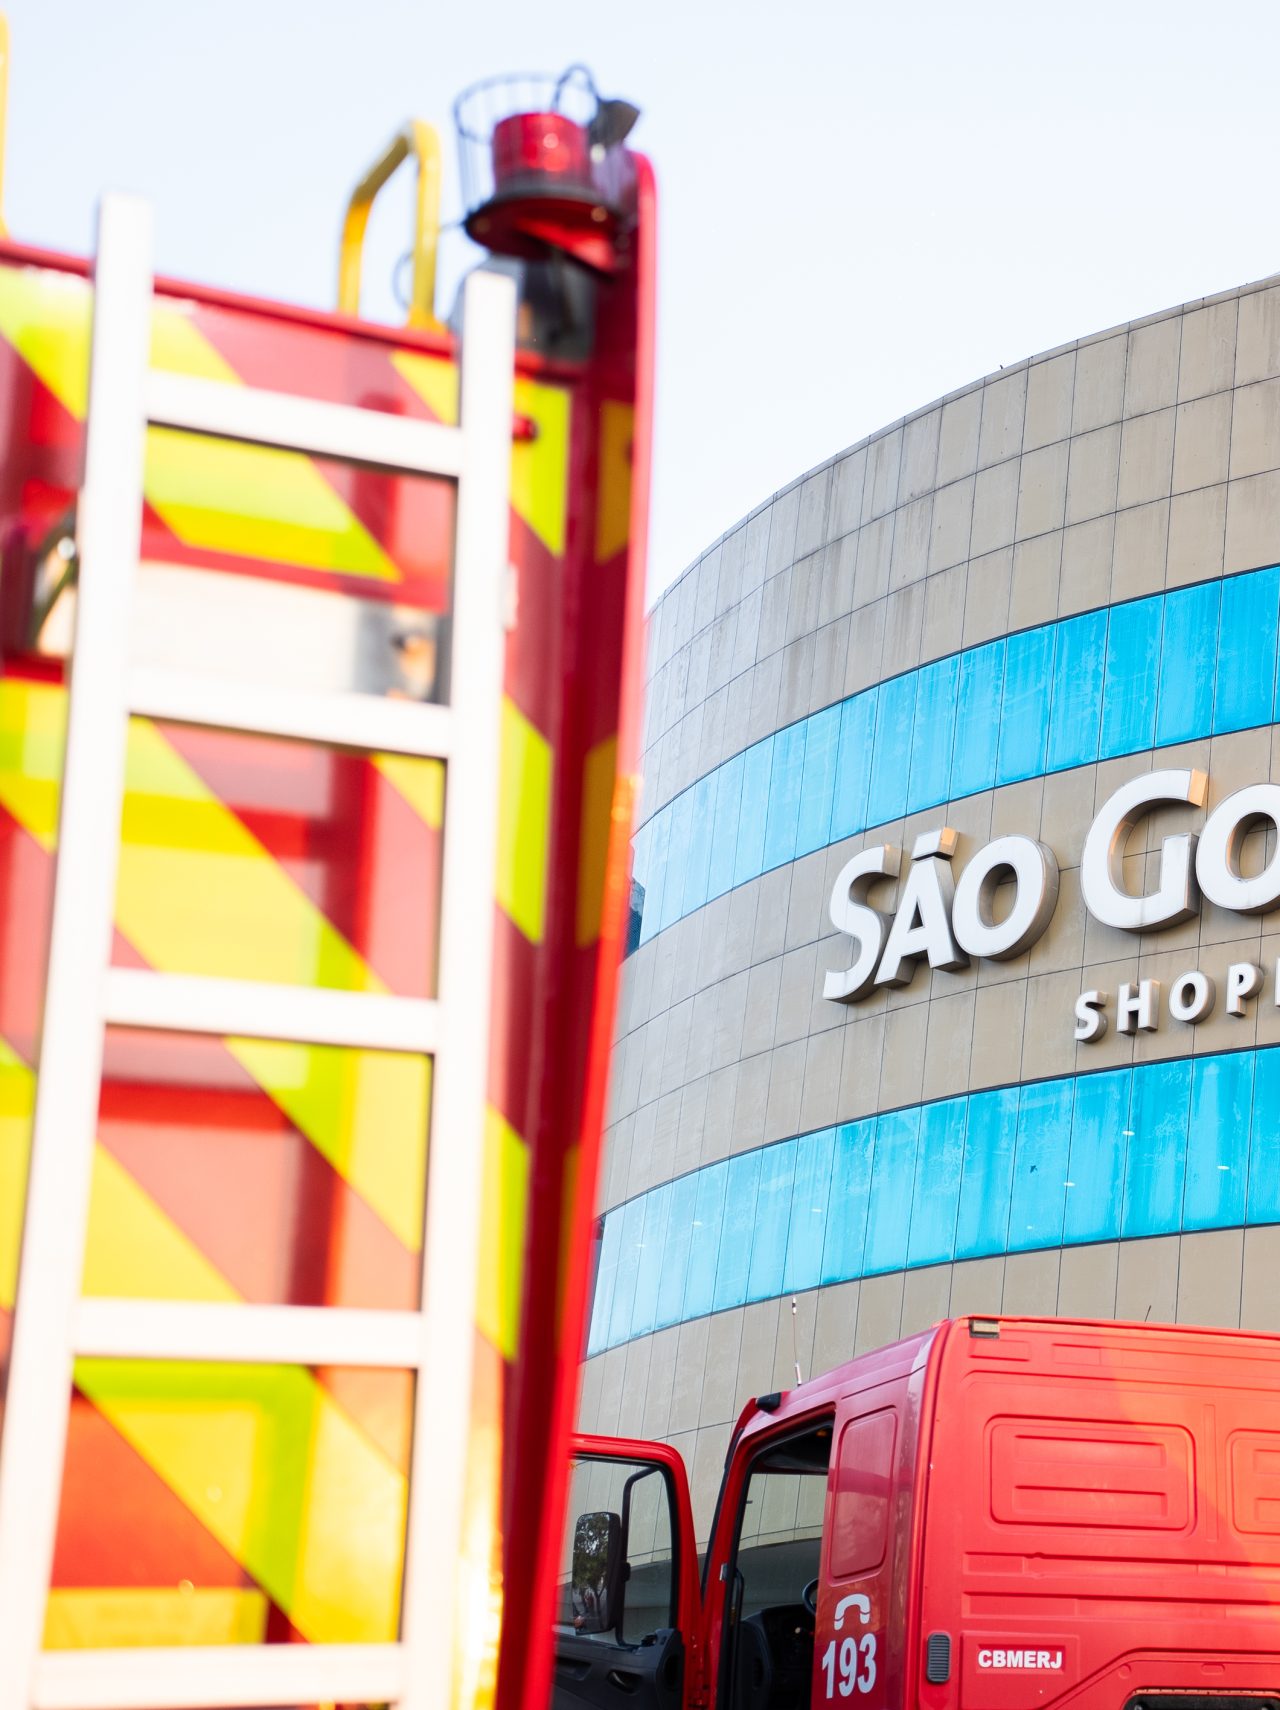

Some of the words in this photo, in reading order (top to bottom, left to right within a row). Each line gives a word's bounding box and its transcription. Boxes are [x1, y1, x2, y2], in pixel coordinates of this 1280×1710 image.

[822, 828, 1060, 1003] SÃO
[821, 1632, 877, 1699] 193
[978, 1649, 1062, 1669] CBMERJ
